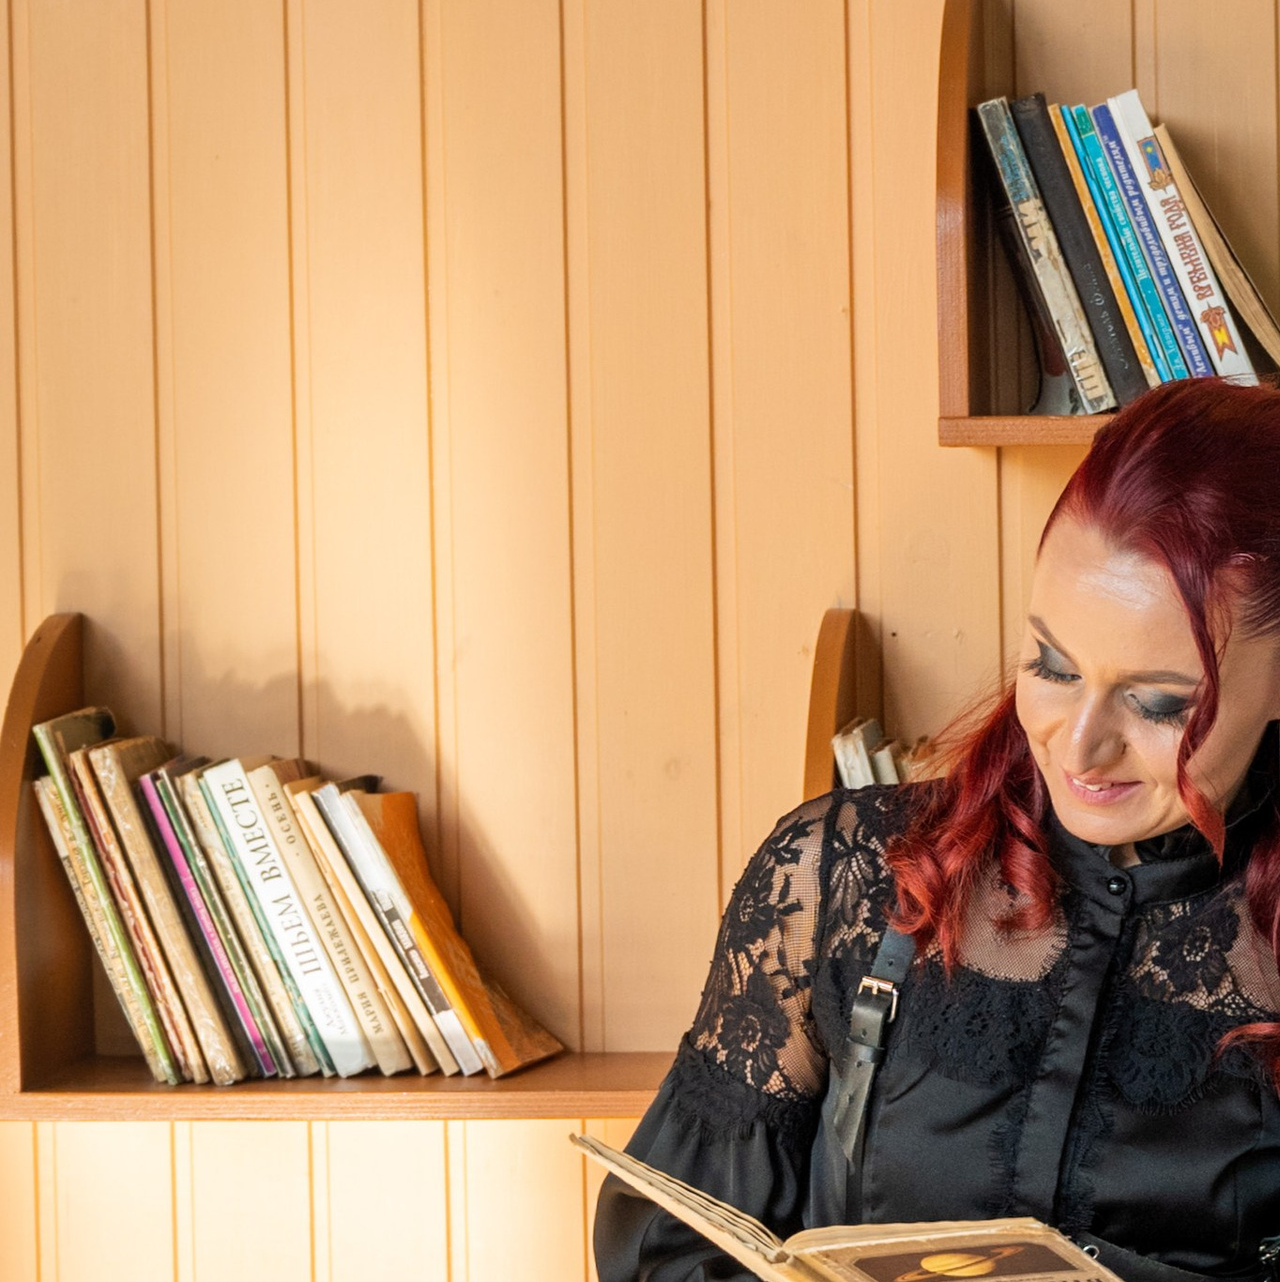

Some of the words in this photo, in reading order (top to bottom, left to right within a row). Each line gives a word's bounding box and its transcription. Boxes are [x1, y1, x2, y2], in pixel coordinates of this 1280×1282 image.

[1093, 155, 1114, 190] чеснока
[1127, 197, 1170, 278] трудолюбивым
[1157, 193, 1189, 232] ГОДА
[1162, 276, 1172, 285] и
[1169, 229, 1217, 302] ВРЕМЕНА
[1164, 285, 1188, 322] детям
[220, 775, 283, 886] ВМЕСТЕ
[265, 790, 298, 845] ОСЕНЬ
[270, 892, 323, 978] ШЬЕМ
[310, 891, 360, 984] ПРИЛЕЖАЕВА
[356, 989, 385, 1036] МАРИЯ
